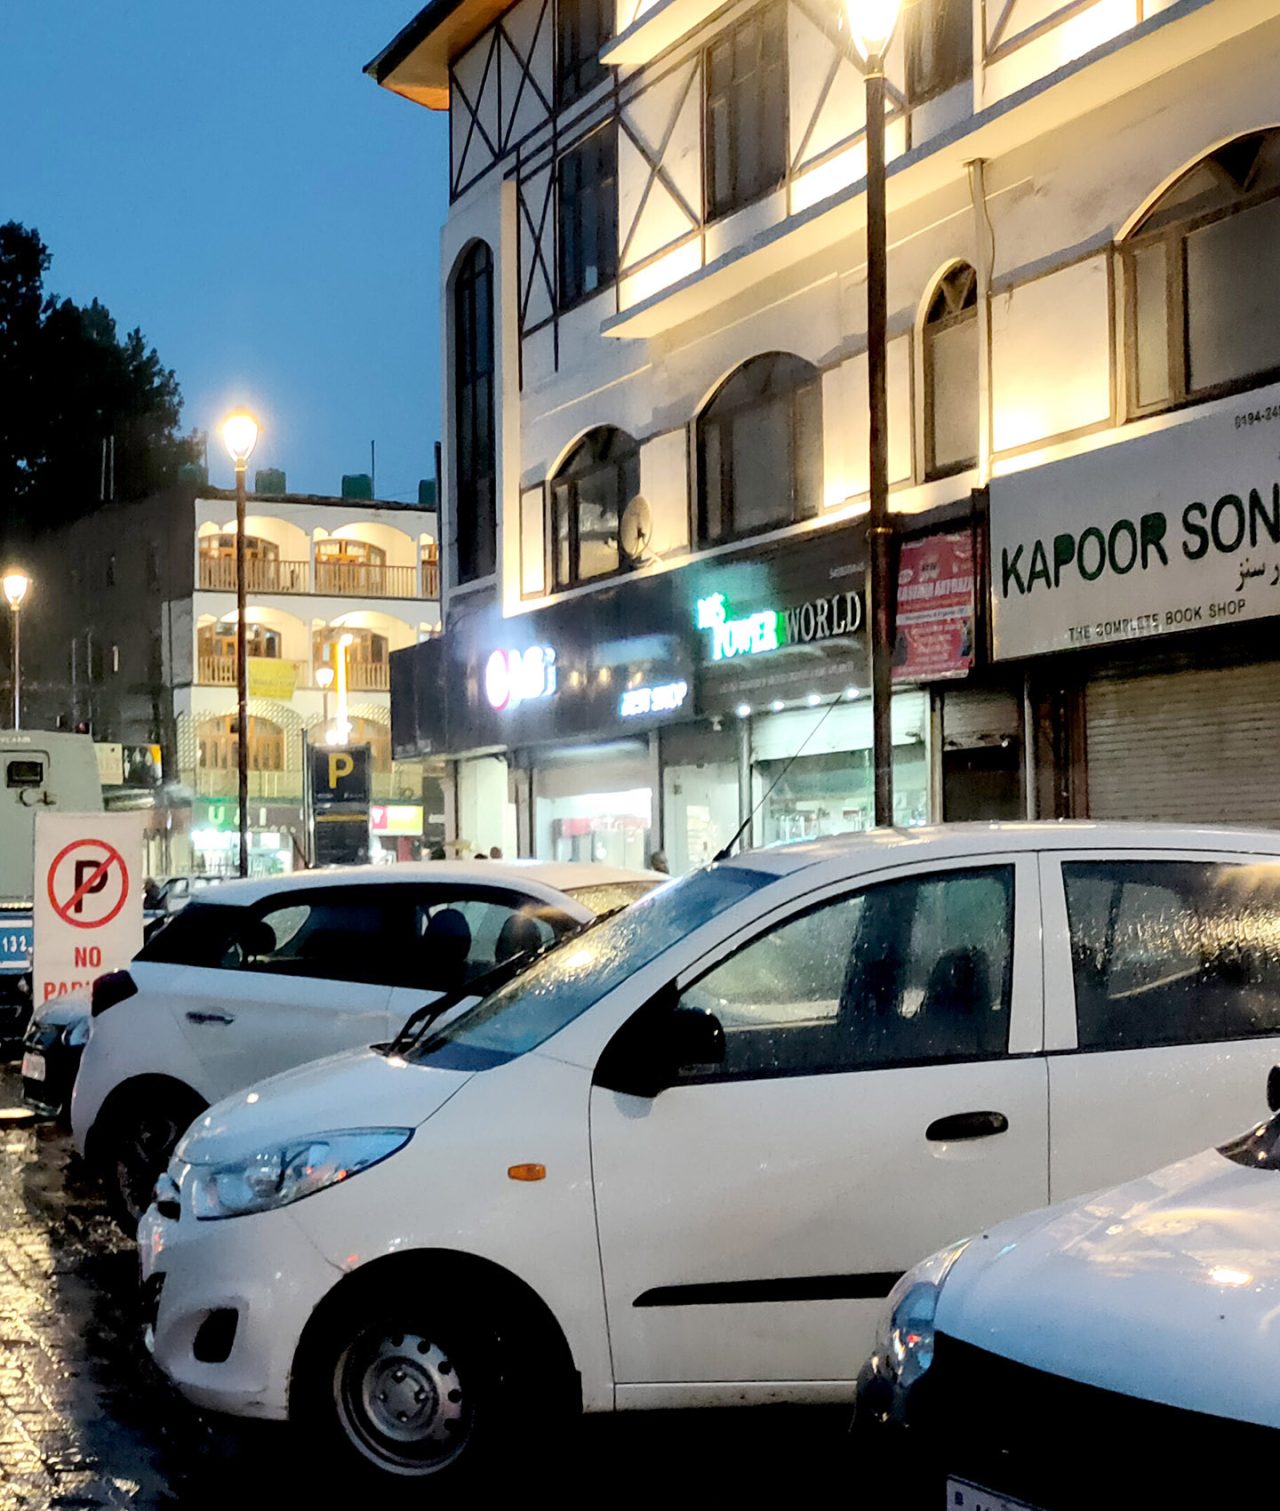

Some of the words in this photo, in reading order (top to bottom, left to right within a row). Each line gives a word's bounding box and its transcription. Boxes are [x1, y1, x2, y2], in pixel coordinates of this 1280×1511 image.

[1001, 511, 1168, 599] KAPOOR
[785, 590, 862, 645] WORLD
[1068, 625, 1091, 641] THE
[1096, 612, 1160, 638] COMPLETE
[1165, 605, 1203, 627] BOOK
[1208, 598, 1247, 620] SHOP
[328, 752, 355, 789] P
[74, 859, 109, 914] P
[74, 946, 102, 968] NO
